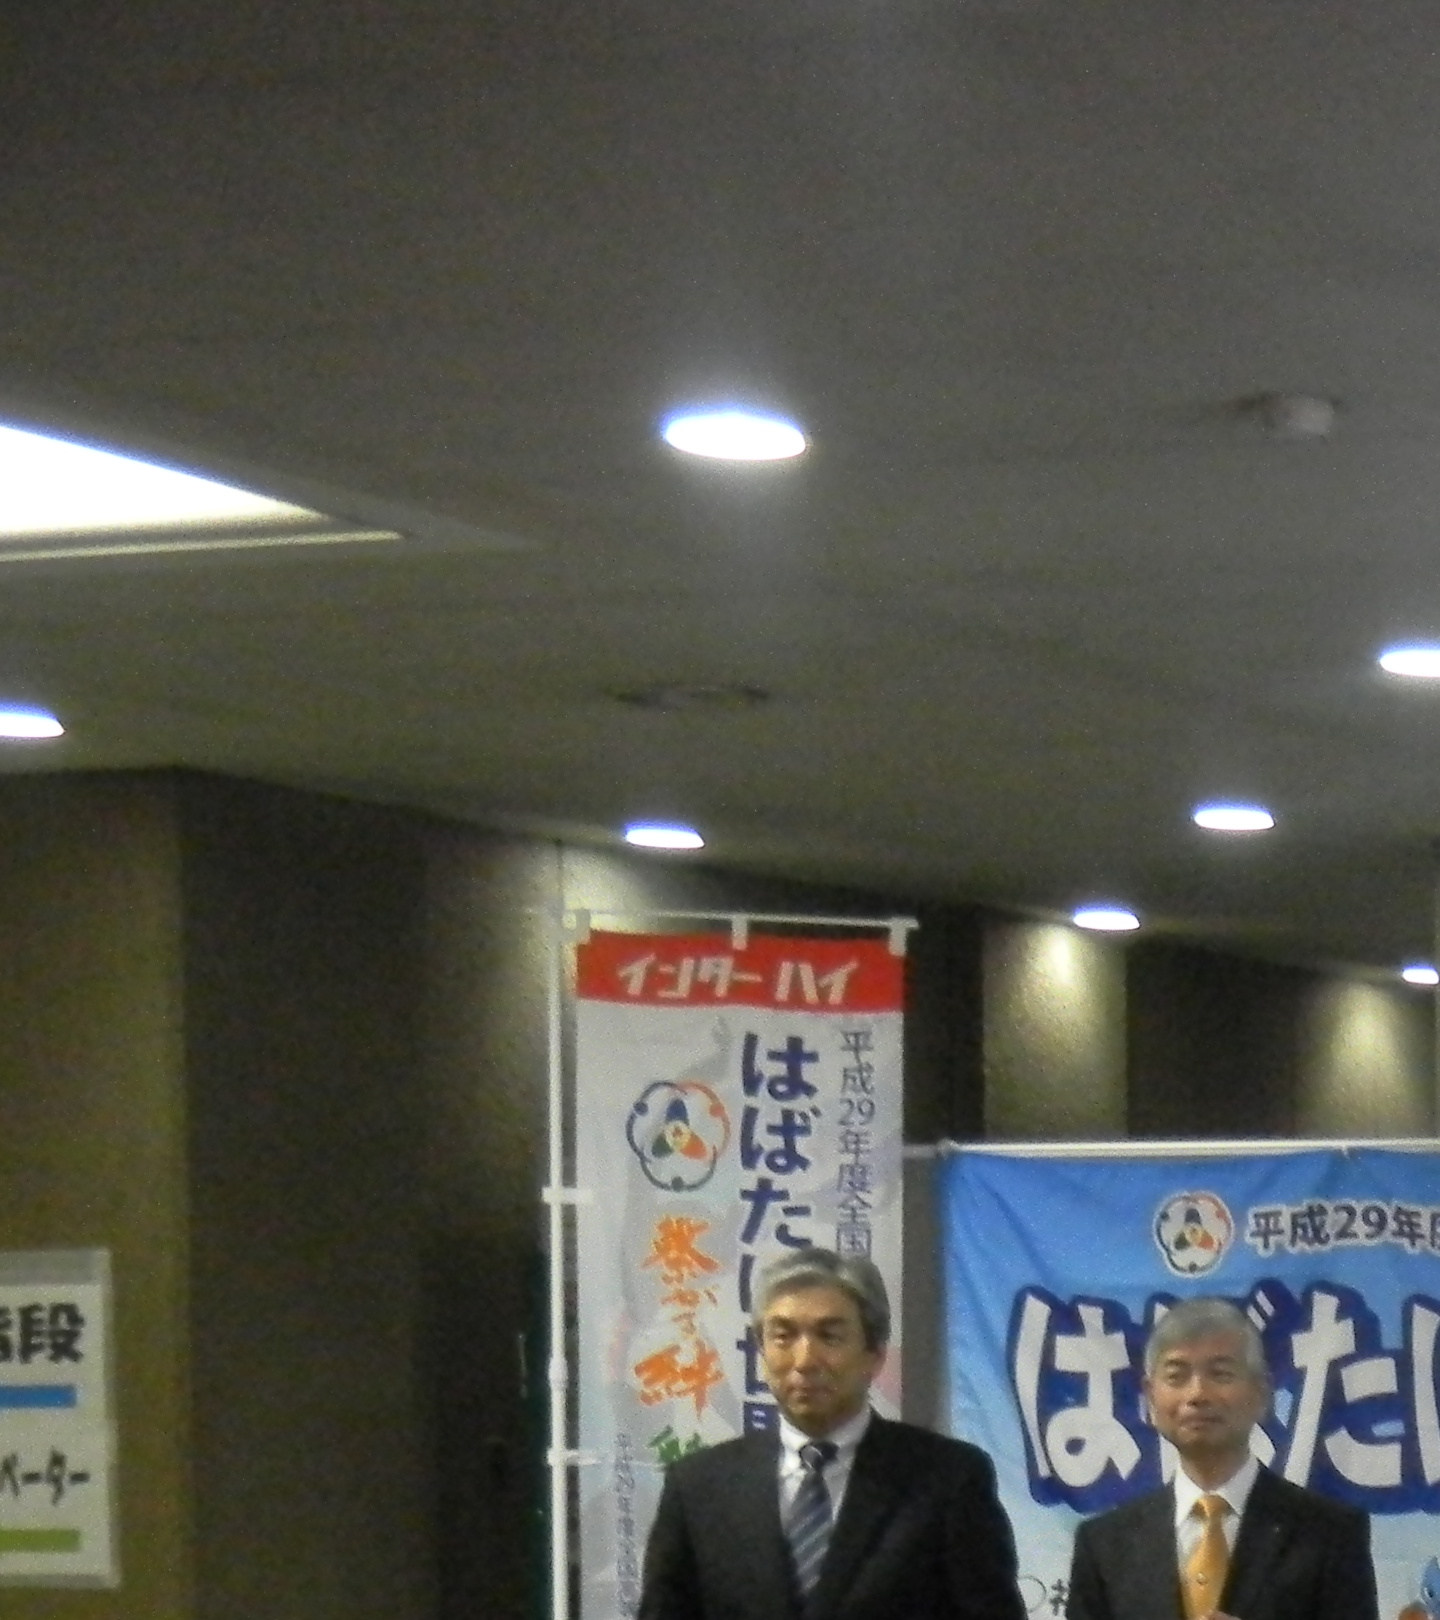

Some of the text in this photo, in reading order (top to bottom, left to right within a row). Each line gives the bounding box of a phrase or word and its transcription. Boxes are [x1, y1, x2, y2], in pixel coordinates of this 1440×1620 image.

[617, 952, 858, 1005] インターハイ
